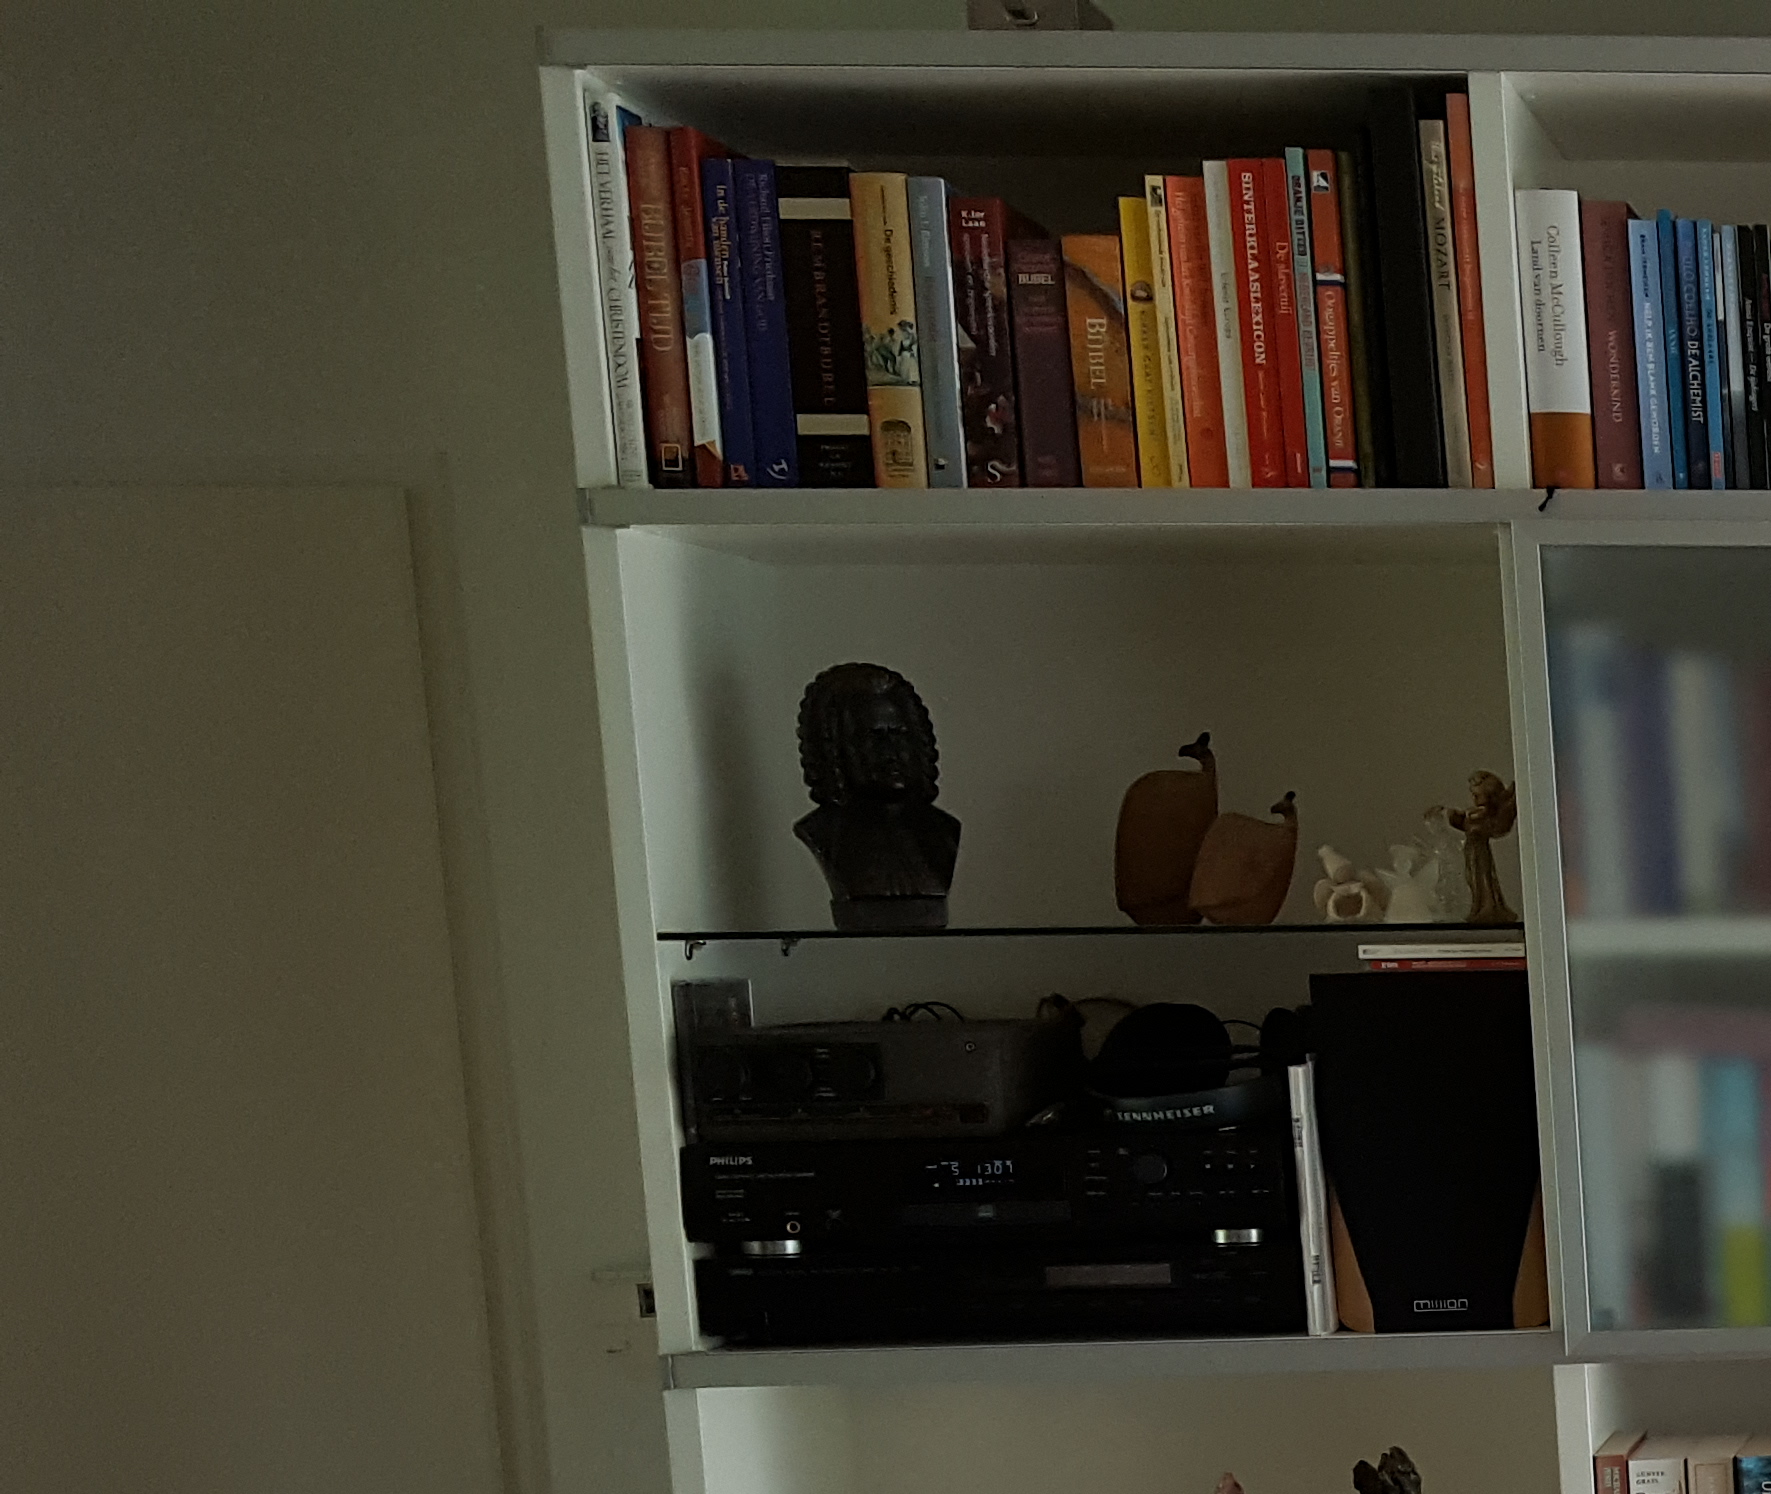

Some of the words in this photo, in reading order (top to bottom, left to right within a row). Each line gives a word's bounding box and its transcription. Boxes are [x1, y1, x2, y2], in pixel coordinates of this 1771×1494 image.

[1240, 173, 1265, 364] SINTERKLAASLEXICON
[1433, 217, 1450, 290] MOZART
[1546, 225, 1562, 278] Colleen
[1546, 283, 1568, 366] McCullough
[709, 1157, 753, 1166] PHILIPS
